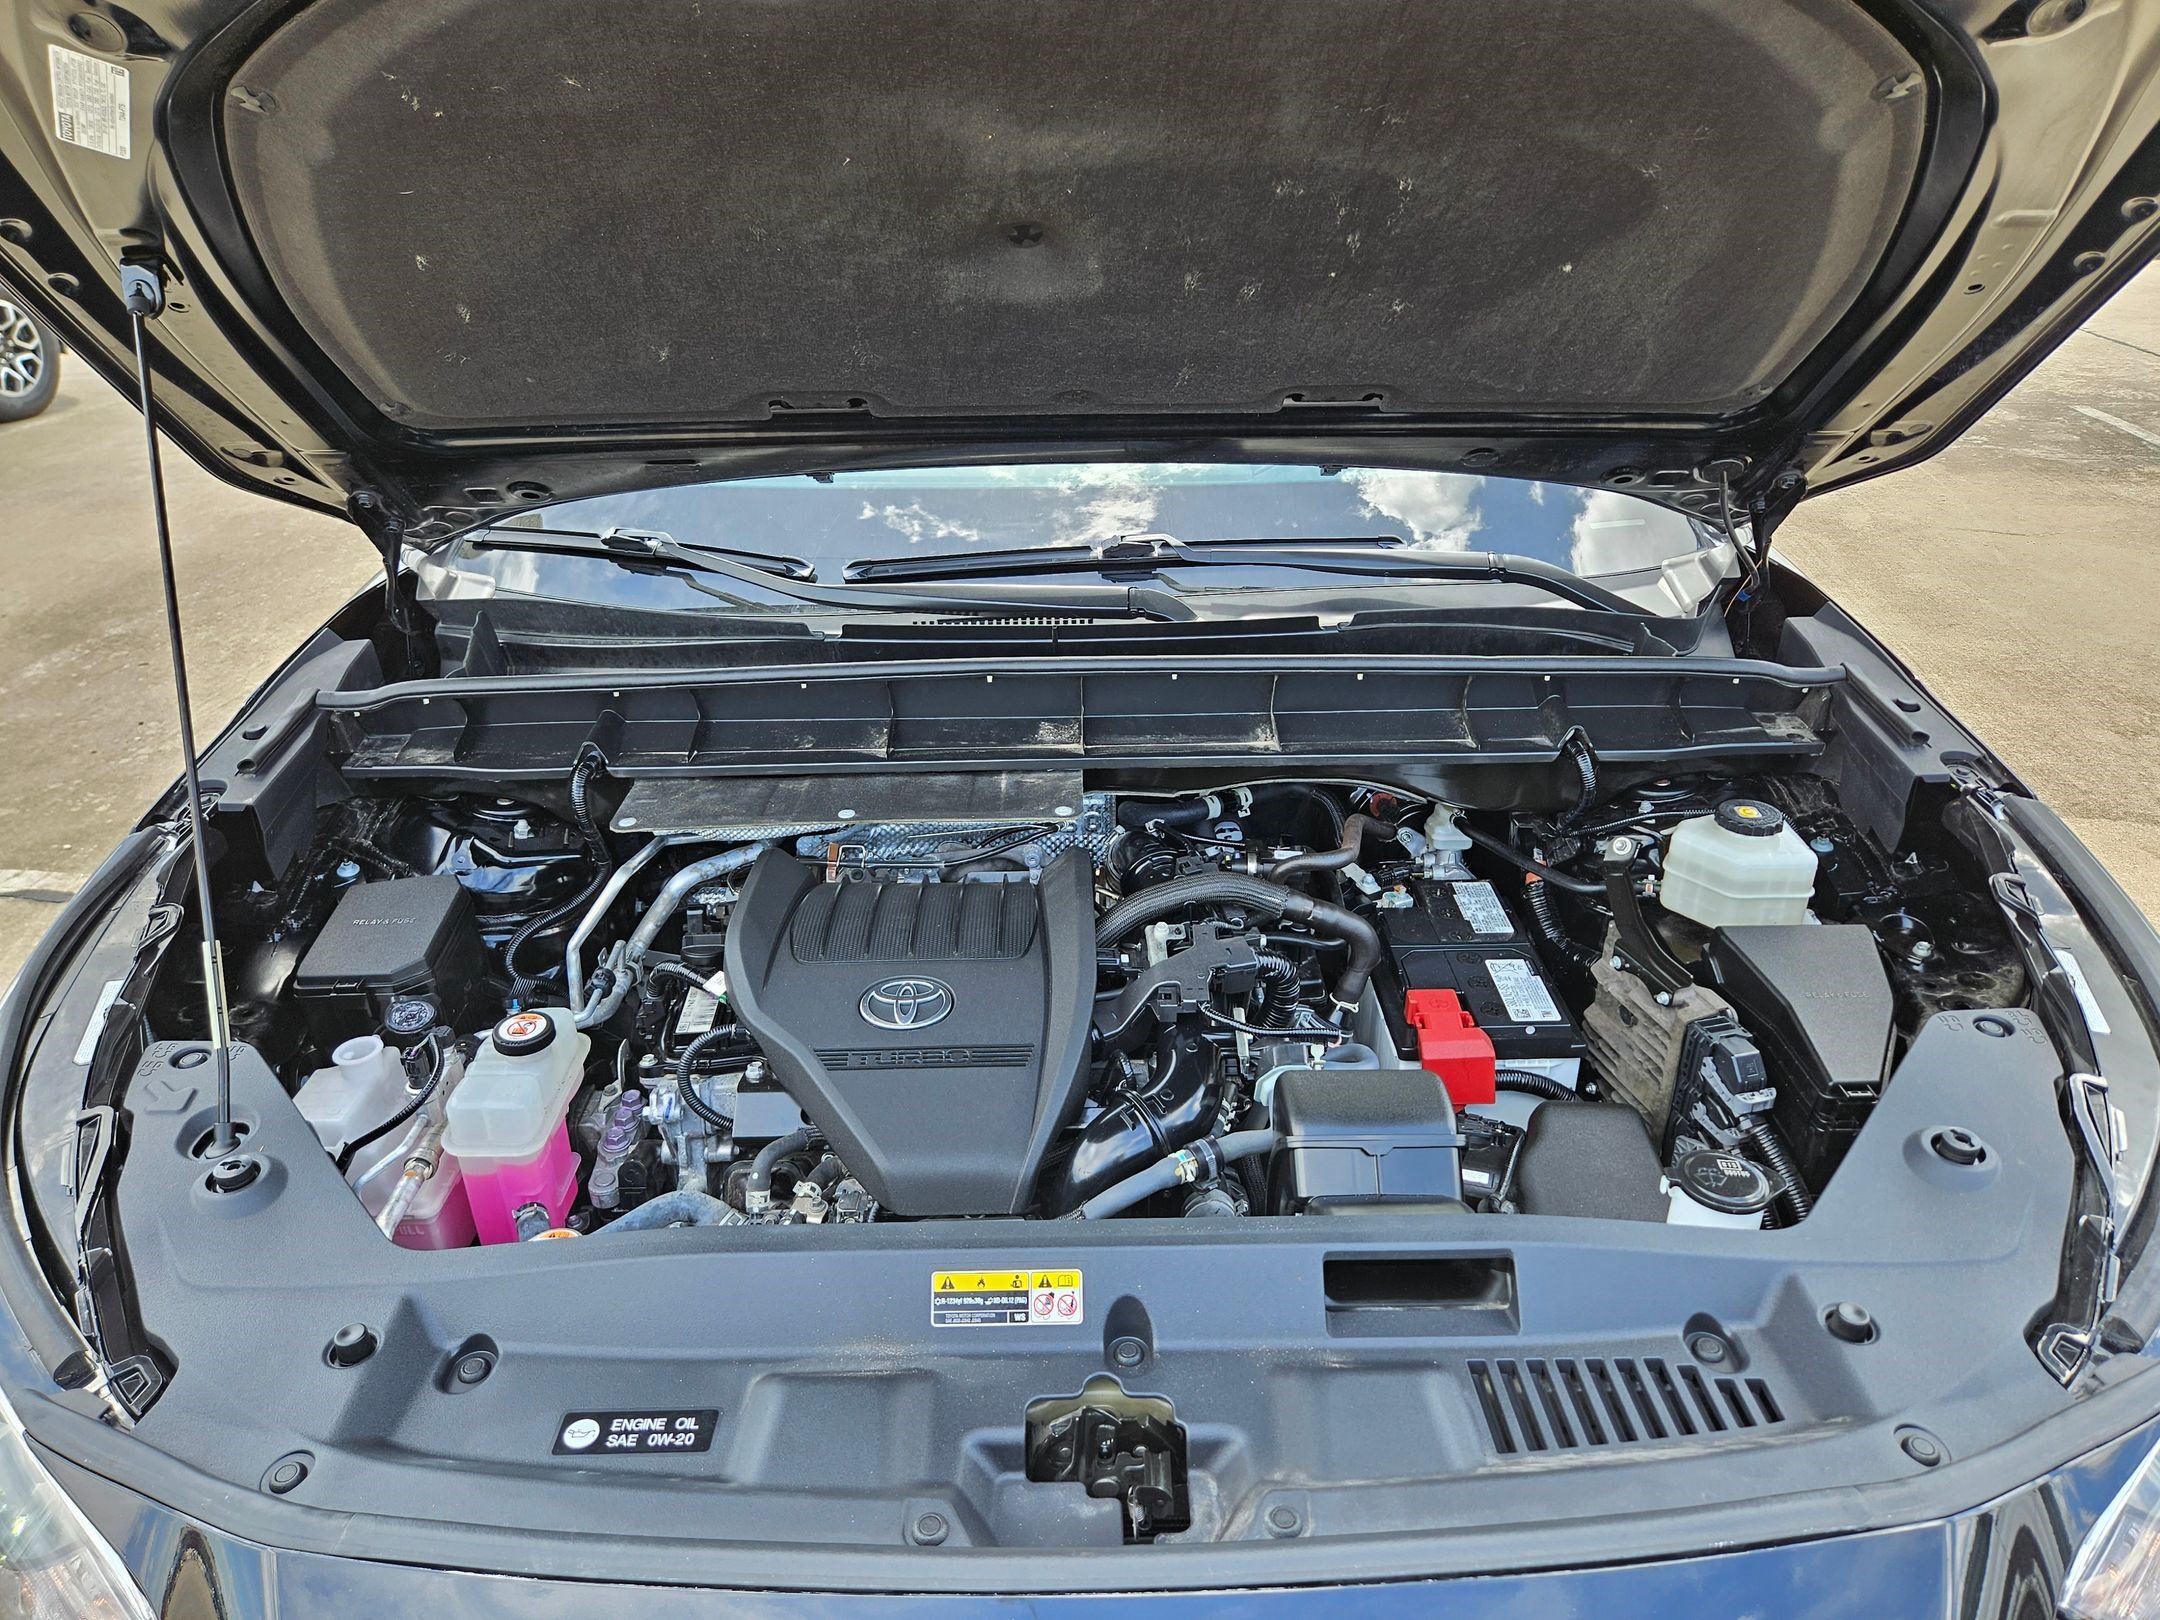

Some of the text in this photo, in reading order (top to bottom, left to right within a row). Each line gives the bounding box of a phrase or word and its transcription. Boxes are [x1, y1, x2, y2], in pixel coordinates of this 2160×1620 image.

[850, 1048, 970, 1065] TURBO
[610, 1417, 699, 1431] ENGINE OIL
[605, 1433, 695, 1447] SAE 0W-20
